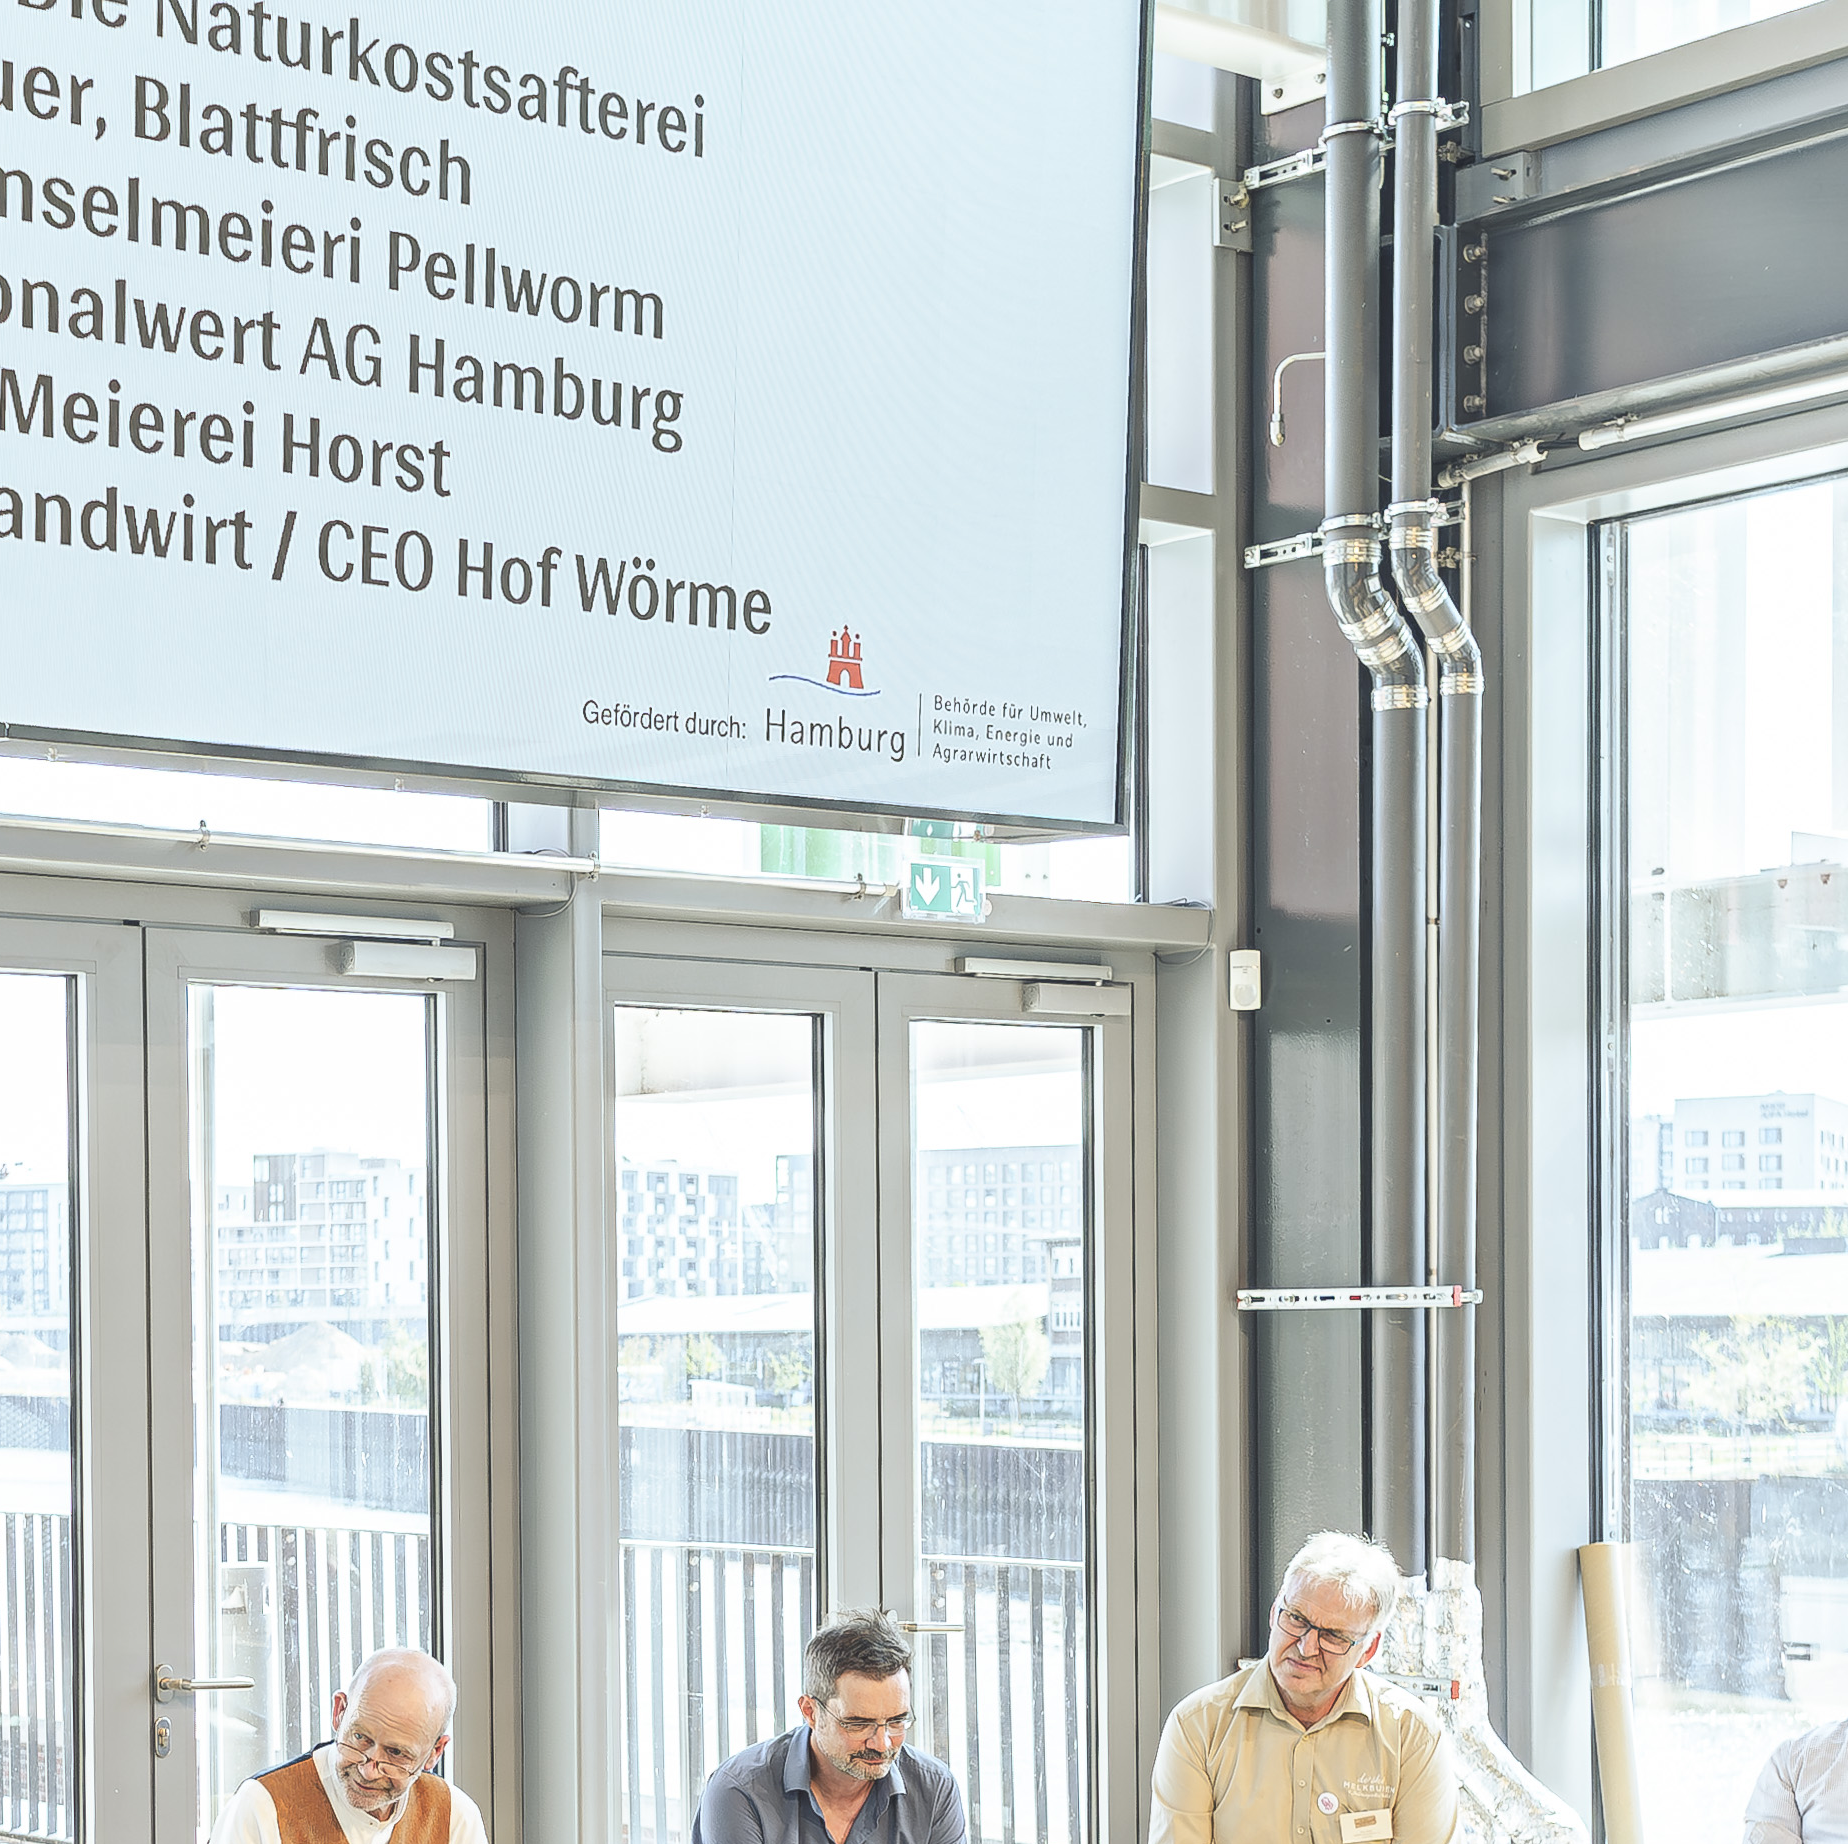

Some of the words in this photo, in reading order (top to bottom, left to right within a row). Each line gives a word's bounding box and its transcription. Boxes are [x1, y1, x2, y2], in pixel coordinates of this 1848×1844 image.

[156, 0, 705, 159] Naturkostsafterei
[134, 74, 471, 206] Blattfrisch
[388, 230, 664, 340] Pellworm
[299, 316, 382, 388] AG
[408, 333, 684, 454] Hamburg
[282, 412, 452, 498] Horst
[271, 510, 298, 582] /
[318, 519, 434, 593] CEO
[456, 538, 565, 610] Hof
[575, 557, 772, 635] Wörme
[582, 699, 680, 733] Gefördert
[685, 711, 747, 740] durch:
[766, 707, 906, 763] Hamburg
[933, 718, 980, 741] Klima,
[986, 724, 1042, 748] Energie
[1047, 733, 1074, 749] und
[934, 695, 996, 717] Behörde
[1002, 702, 1024, 719] für
[1030, 705, 1088, 729] Umwelt,
[932, 742, 1052, 771] Agrarwirtschaft
